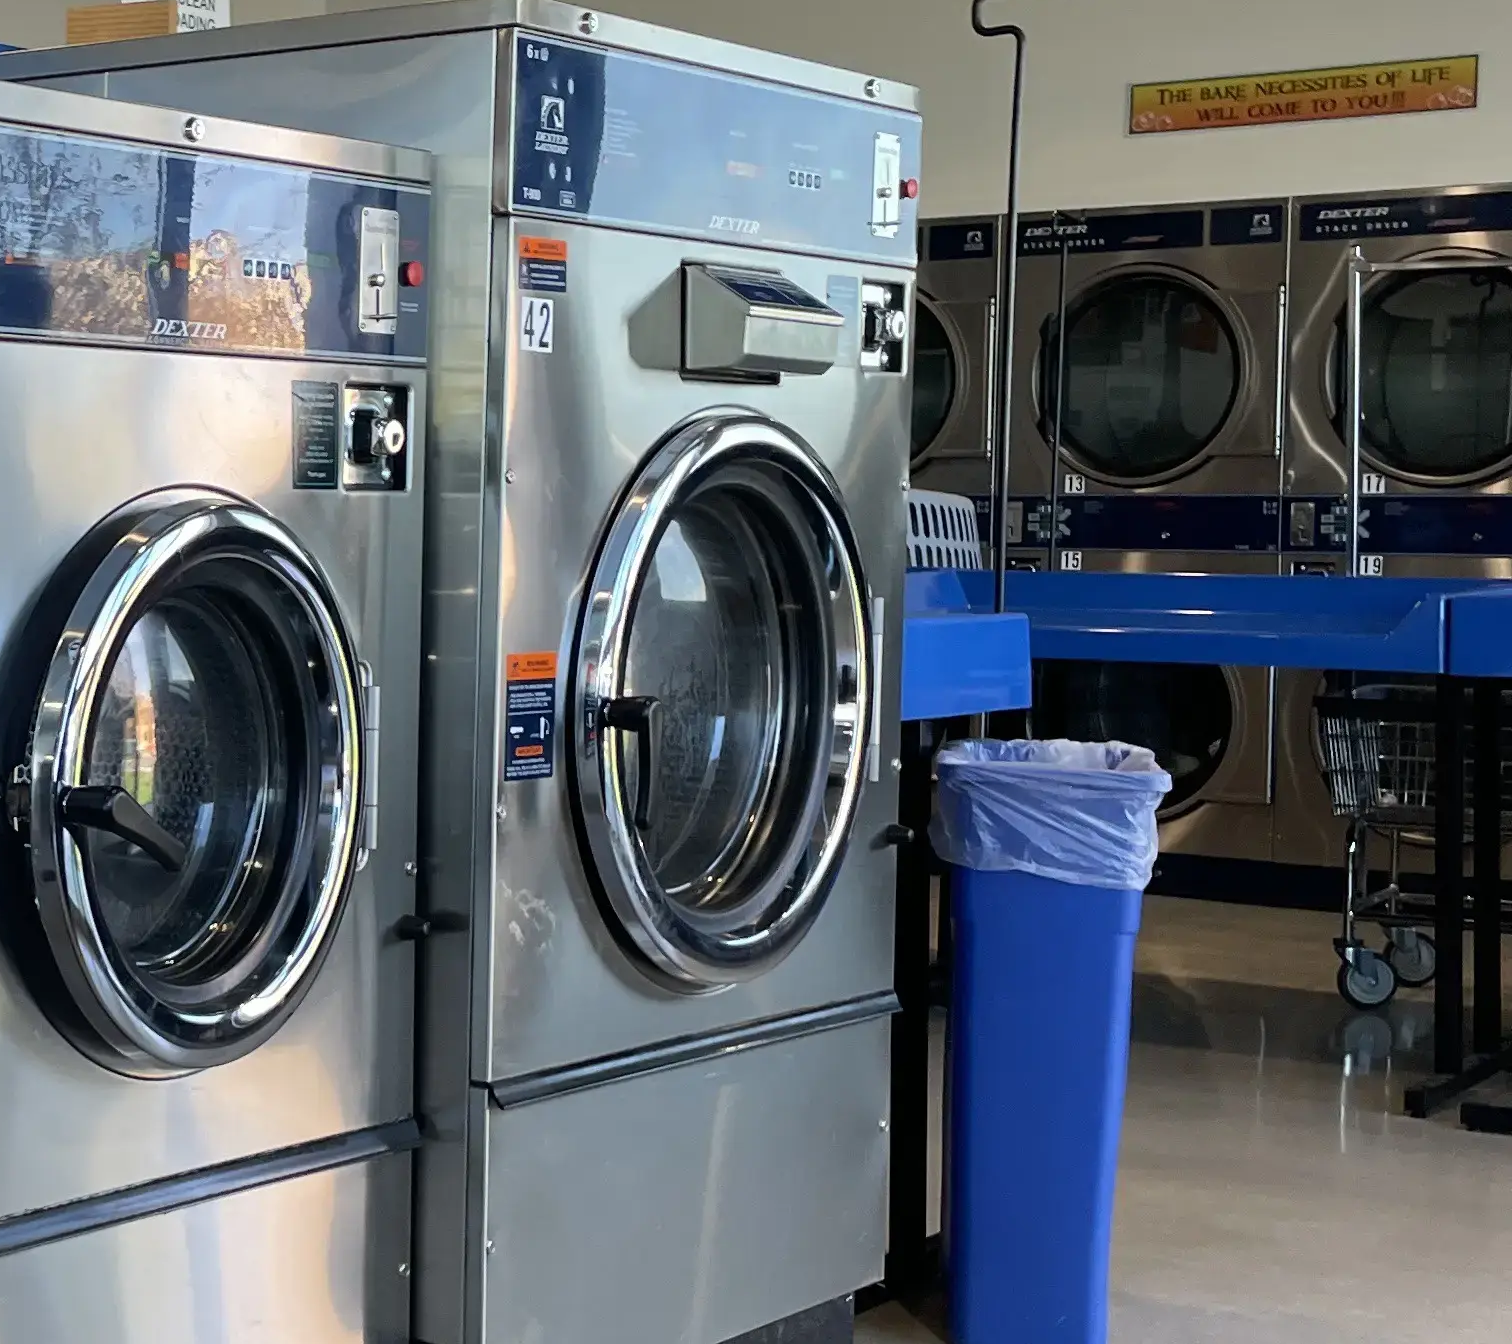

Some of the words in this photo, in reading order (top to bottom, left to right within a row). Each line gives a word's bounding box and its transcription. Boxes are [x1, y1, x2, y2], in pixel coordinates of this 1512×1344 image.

[1156, 88, 1192, 105] THE
[1200, 83, 1247, 102] BARE
[1255, 73, 1367, 98] NECESSITIES
[1375, 69, 1402, 88] OF
[1411, 66, 1451, 85] LIFE
[1196, 107, 1239, 122] WILL
[1248, 101, 1301, 118] COME
[1311, 97, 1337, 113] TO
[1318, 206, 1389, 219] DEXTER
[151, 318, 228, 339] DEXTER
[524, 301, 550, 348] 42
[1067, 476, 1084, 493] 13
[1365, 475, 1384, 492] 17
[1063, 553, 1080, 569] 15
[1363, 557, 1381, 574] 19
